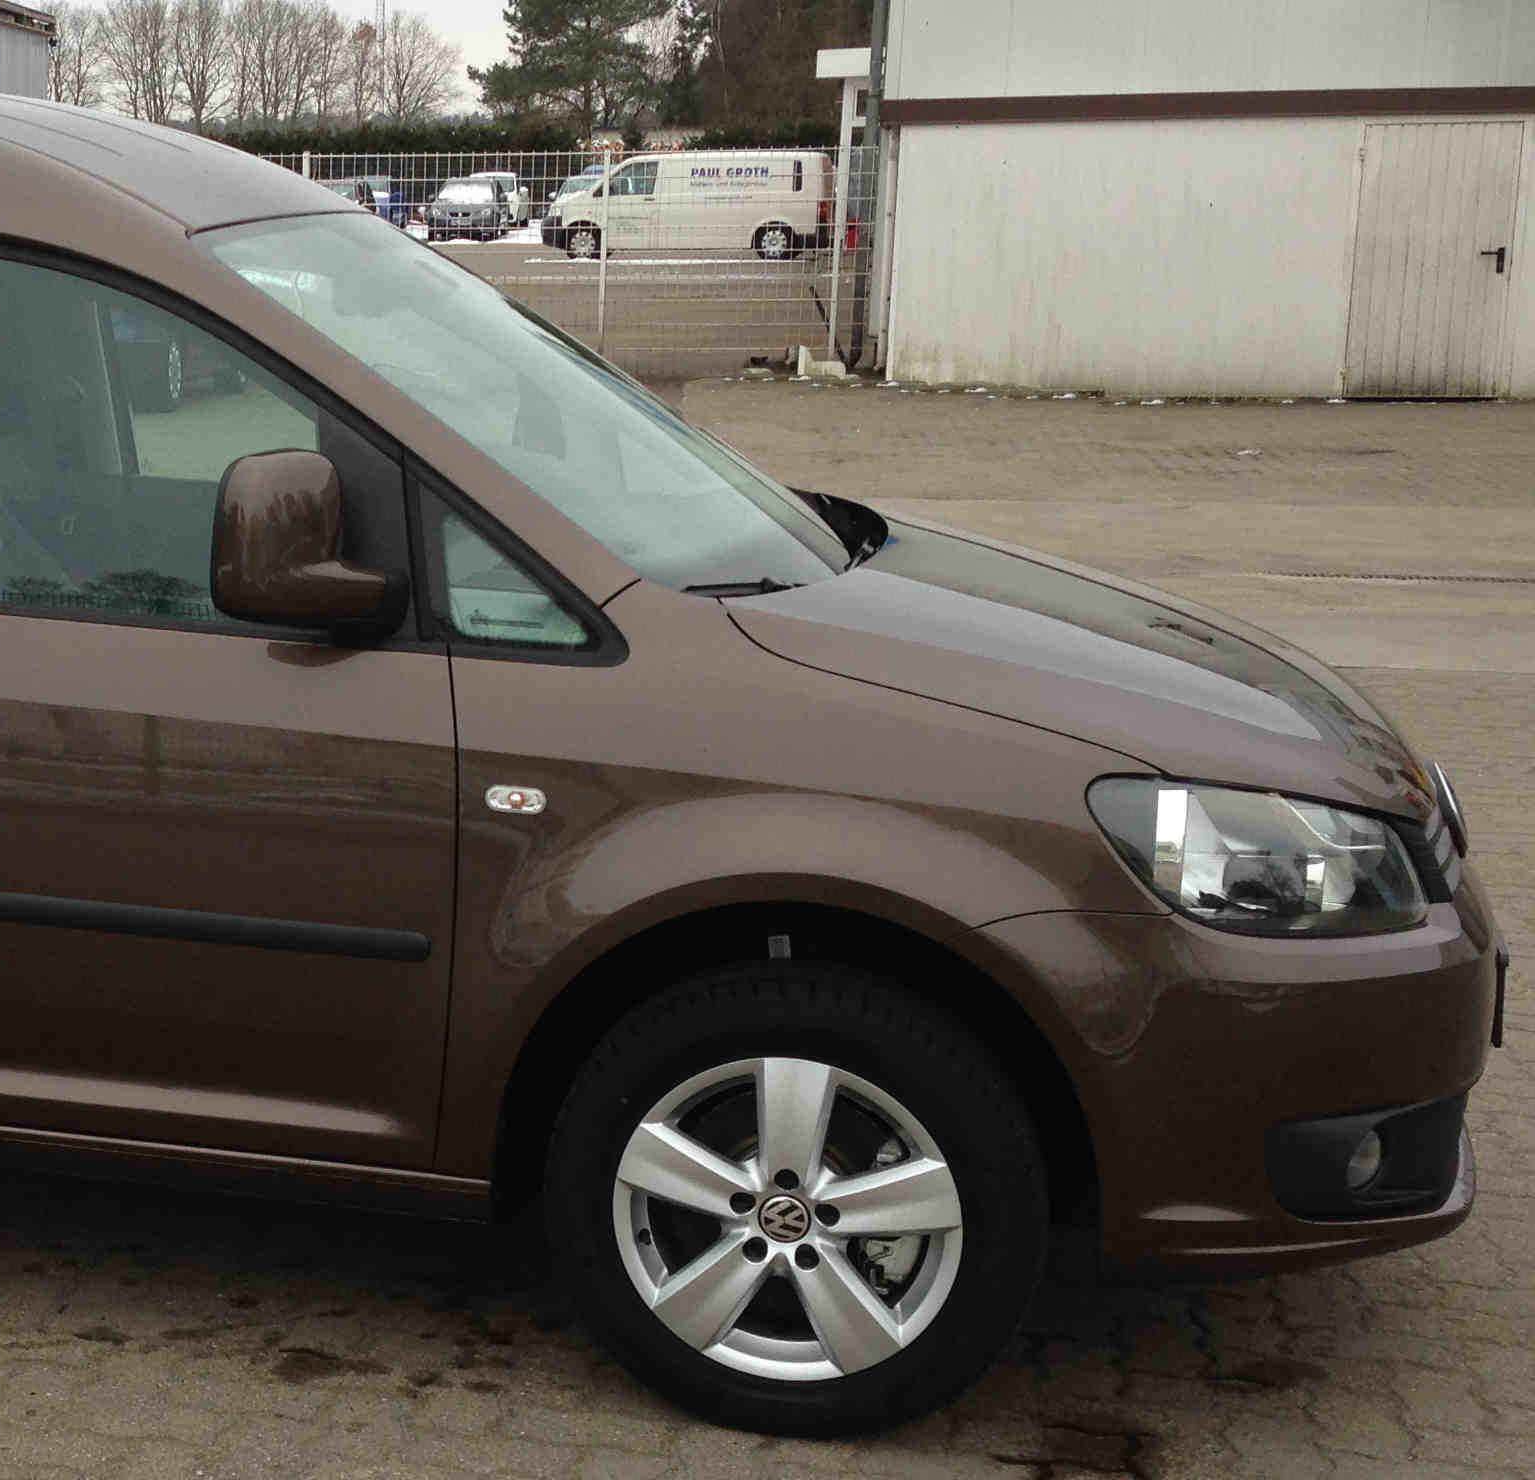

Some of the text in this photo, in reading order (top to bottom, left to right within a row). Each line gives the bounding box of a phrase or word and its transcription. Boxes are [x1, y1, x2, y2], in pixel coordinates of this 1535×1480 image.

[691, 166, 769, 177] PAUL GROTH
[760, 1196, 809, 1242] VW
